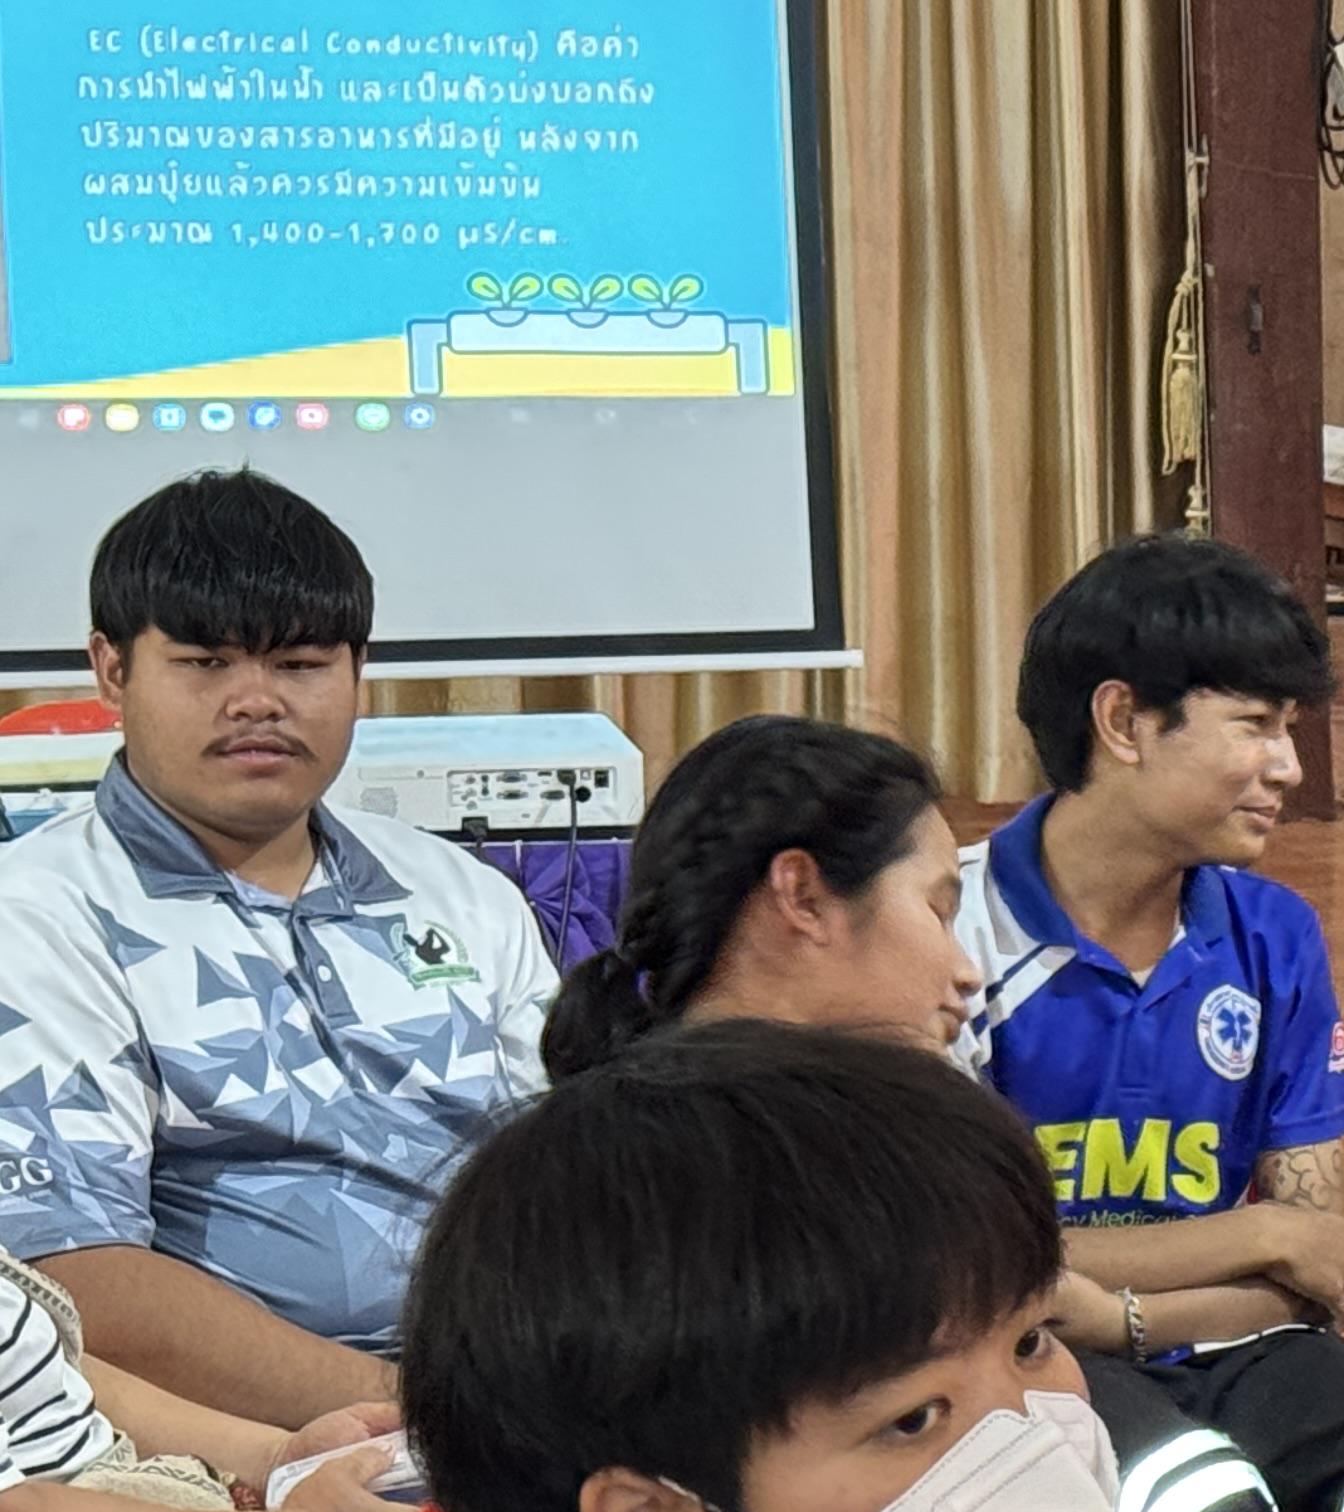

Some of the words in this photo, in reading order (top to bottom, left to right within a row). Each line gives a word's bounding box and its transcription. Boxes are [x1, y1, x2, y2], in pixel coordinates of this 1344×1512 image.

[90, 30, 121, 52] EC
[139, 24, 309, 58] (Electrical
[325, 29, 540, 62] Conductivity)
[556, 23, 640, 58] คือค่า
[81, 116, 501, 159] ปริมาณของสารอาหารที่มีอยู่
[519, 122, 640, 152] หลังจาก
[86, 217, 213, 245] ประมาณ
[231, 220, 441, 250] 1,400-1,700
[1034, 1117, 1221, 1204] EMS
